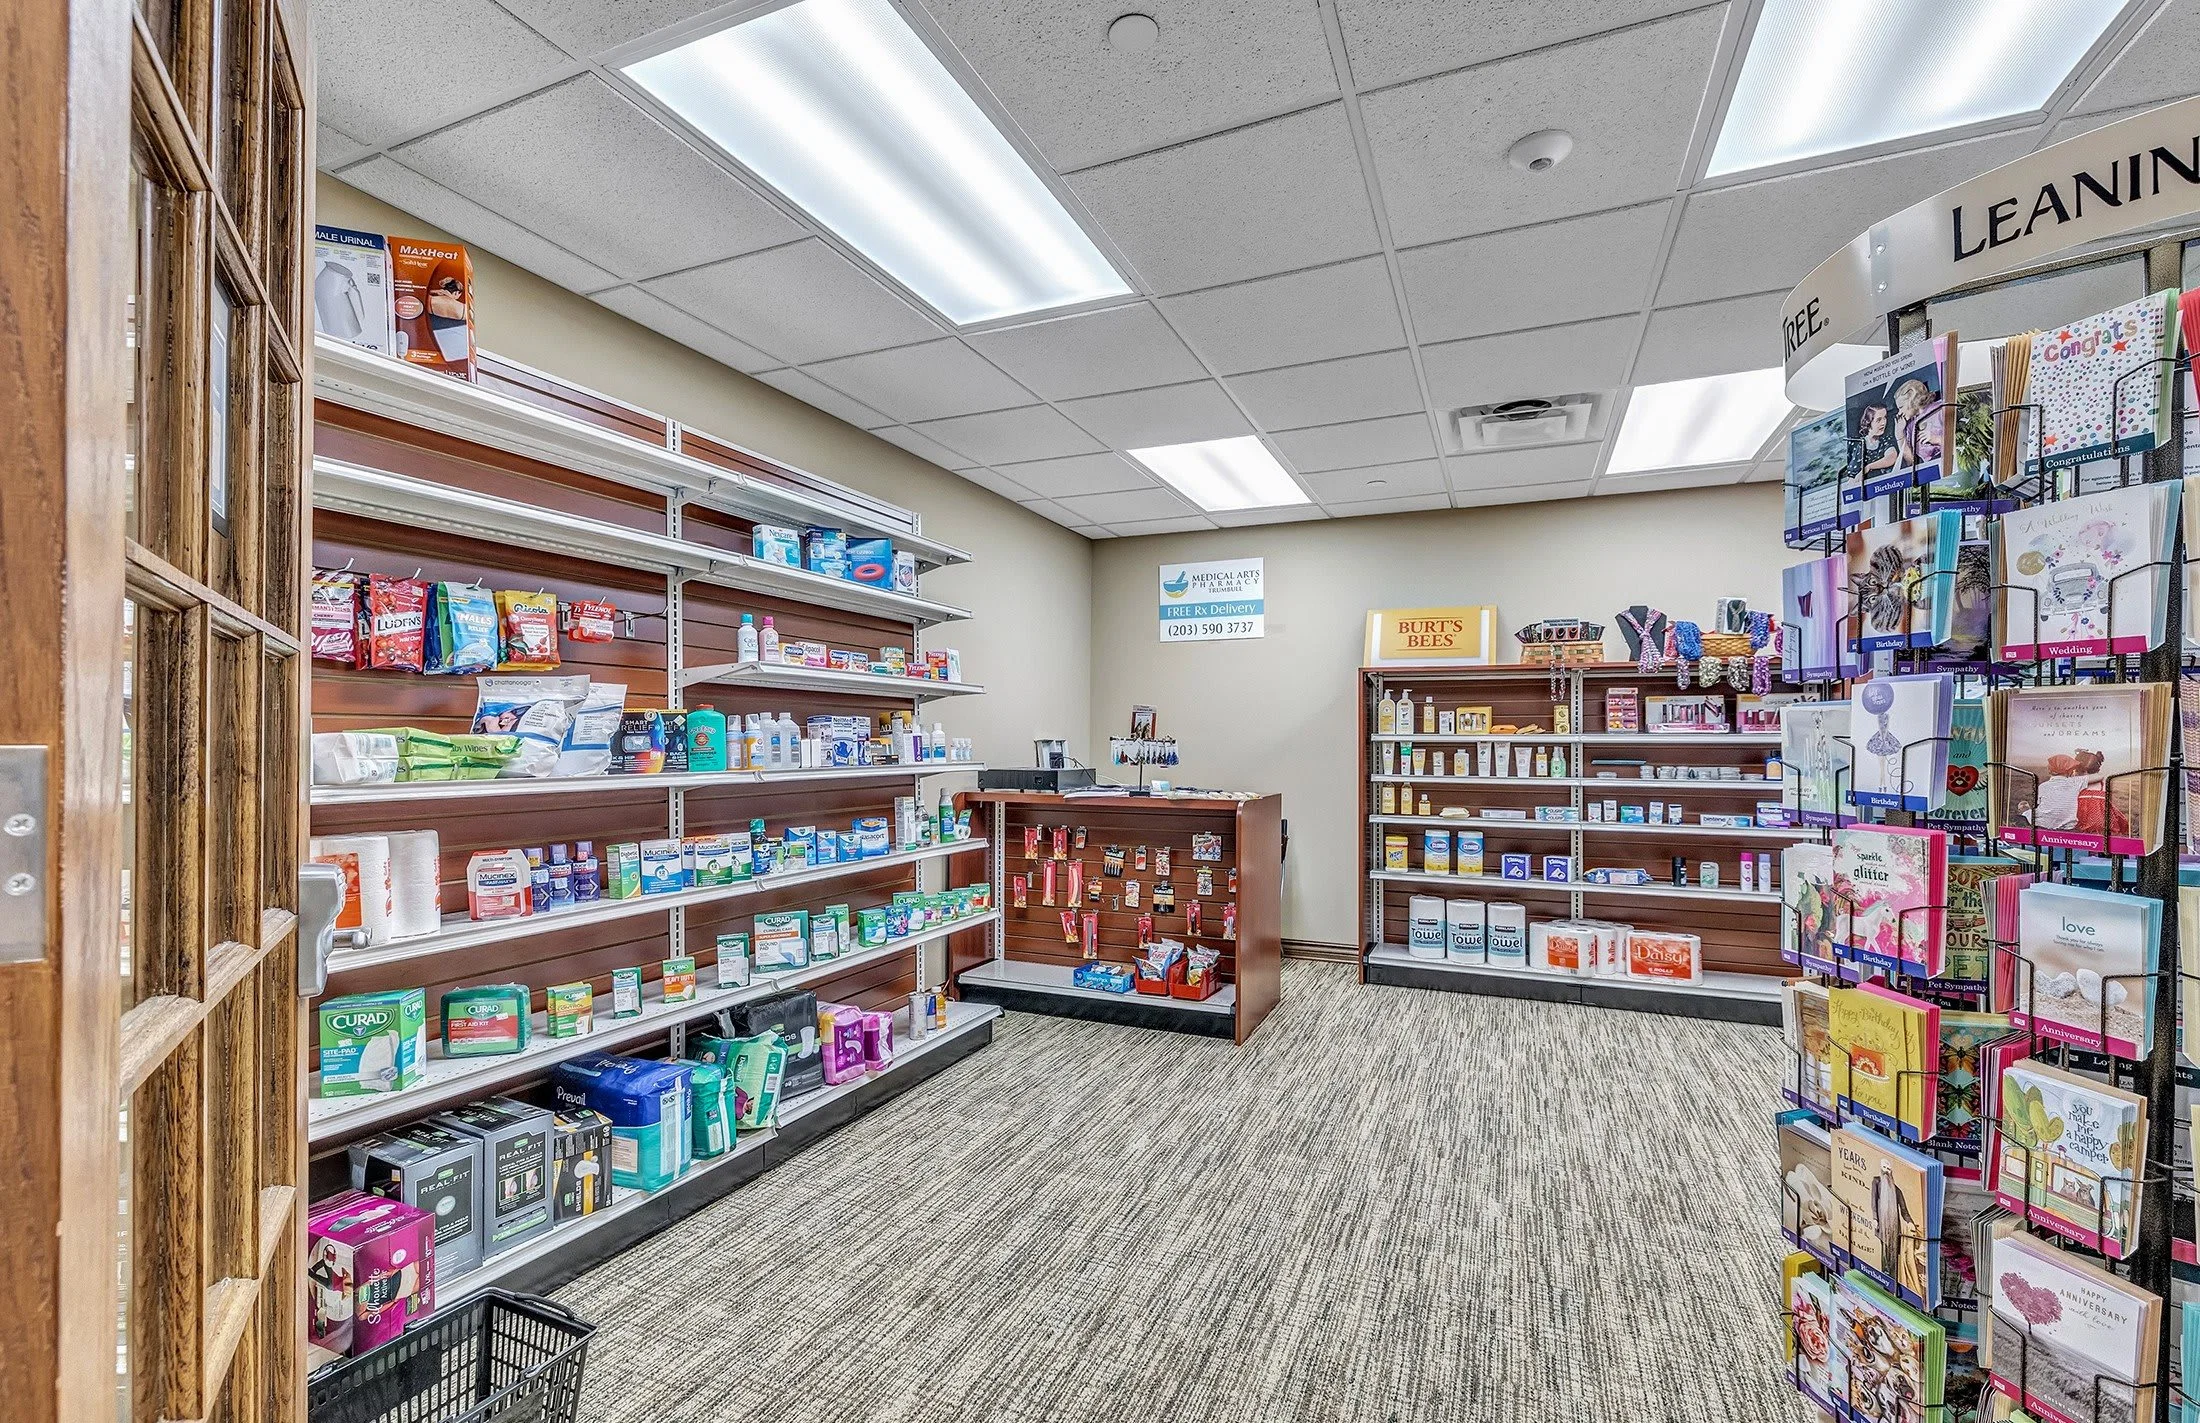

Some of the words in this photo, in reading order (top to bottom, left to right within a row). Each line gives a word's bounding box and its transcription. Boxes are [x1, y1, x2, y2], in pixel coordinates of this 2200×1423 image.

[1952, 136, 2200, 262] LEANIN
[340, 235, 376, 247] URINAL
[400, 245, 459, 260] MAXHeat
[2044, 319, 2138, 362] Congrats
[1873, 371, 1891, 382] BOTTLE
[1892, 367, 1899, 375] OF
[1874, 479, 1905, 494] Birthday
[769, 529, 793, 540] Nexcare
[1192, 572, 1234, 582] MEDICAL
[1237, 570, 1260, 578] ARTS
[1192, 578, 1260, 588] PHARMACY
[513, 603, 549, 615] Ricola
[1167, 606, 1191, 617] FREE
[1194, 606, 1208, 615] Rx
[1211, 603, 1256, 615] Delivery
[459, 613, 493, 626] HALLS
[1168, 624, 1198, 636] (203)
[1202, 623, 1223, 634] 590
[1227, 622, 1254, 633] 3737
[1398, 620, 1463, 634] BURT'S
[1407, 634, 1454, 648] BEES
[1876, 639, 1904, 649] Birthday
[2049, 645, 2093, 656] Wedding
[1806, 670, 1832, 678] Sympathy
[1871, 797, 1899, 807] Birthday
[1805, 814, 1832, 824] Sympathy
[1927, 822, 1940, 830] Pet
[1942, 823, 1987, 833] Sympathy
[2041, 834, 2099, 849] Anniversary
[1857, 853, 1882, 865] sparkle
[1854, 866, 1889, 881] glitter
[898, 897, 920, 905] CURAD
[765, 917, 791, 925] CURAD
[2062, 916, 2096, 936] love
[1411, 928, 1443, 940] Towel
[1489, 935, 1523, 947] Towel
[1637, 945, 1684, 964] Daisy
[1863, 954, 1892, 968] Birthday
[1943, 982, 1987, 992] Sympathy
[404, 1001, 423, 1016] CURAD
[467, 1005, 499, 1015] CURAD
[332, 1013, 388, 1029] CURAD
[1832, 999, 1858, 1022] Happy
[1859, 1008, 1901, 1046] Birthday
[2041, 1025, 2101, 1047] Anniversary
[323, 1047, 357, 1055] SITE-PAD
[2093, 1056, 2133, 1070] Long
[557, 1086, 586, 1105] Prevail
[2073, 1104, 2092, 1116] you
[1863, 1109, 1891, 1127] Birthday
[2068, 1110, 2099, 1129] make
[2077, 1123, 2093, 1136] me
[1955, 1141, 1981, 1150] Notec
[2066, 1130, 2073, 1139] a
[2074, 1132, 2109, 1151] happy
[1838, 1147, 1867, 1171] YEARS
[2069, 1142, 2110, 1164] camper
[2027, 1210, 2087, 1241] Anniversary
[1860, 1263, 1890, 1287] Birthday
[367, 1268, 381, 1324] Silhouette
[2081, 1287, 2107, 1303] HAPPY
[2059, 1288, 2128, 1325] ANNIVERSARY
